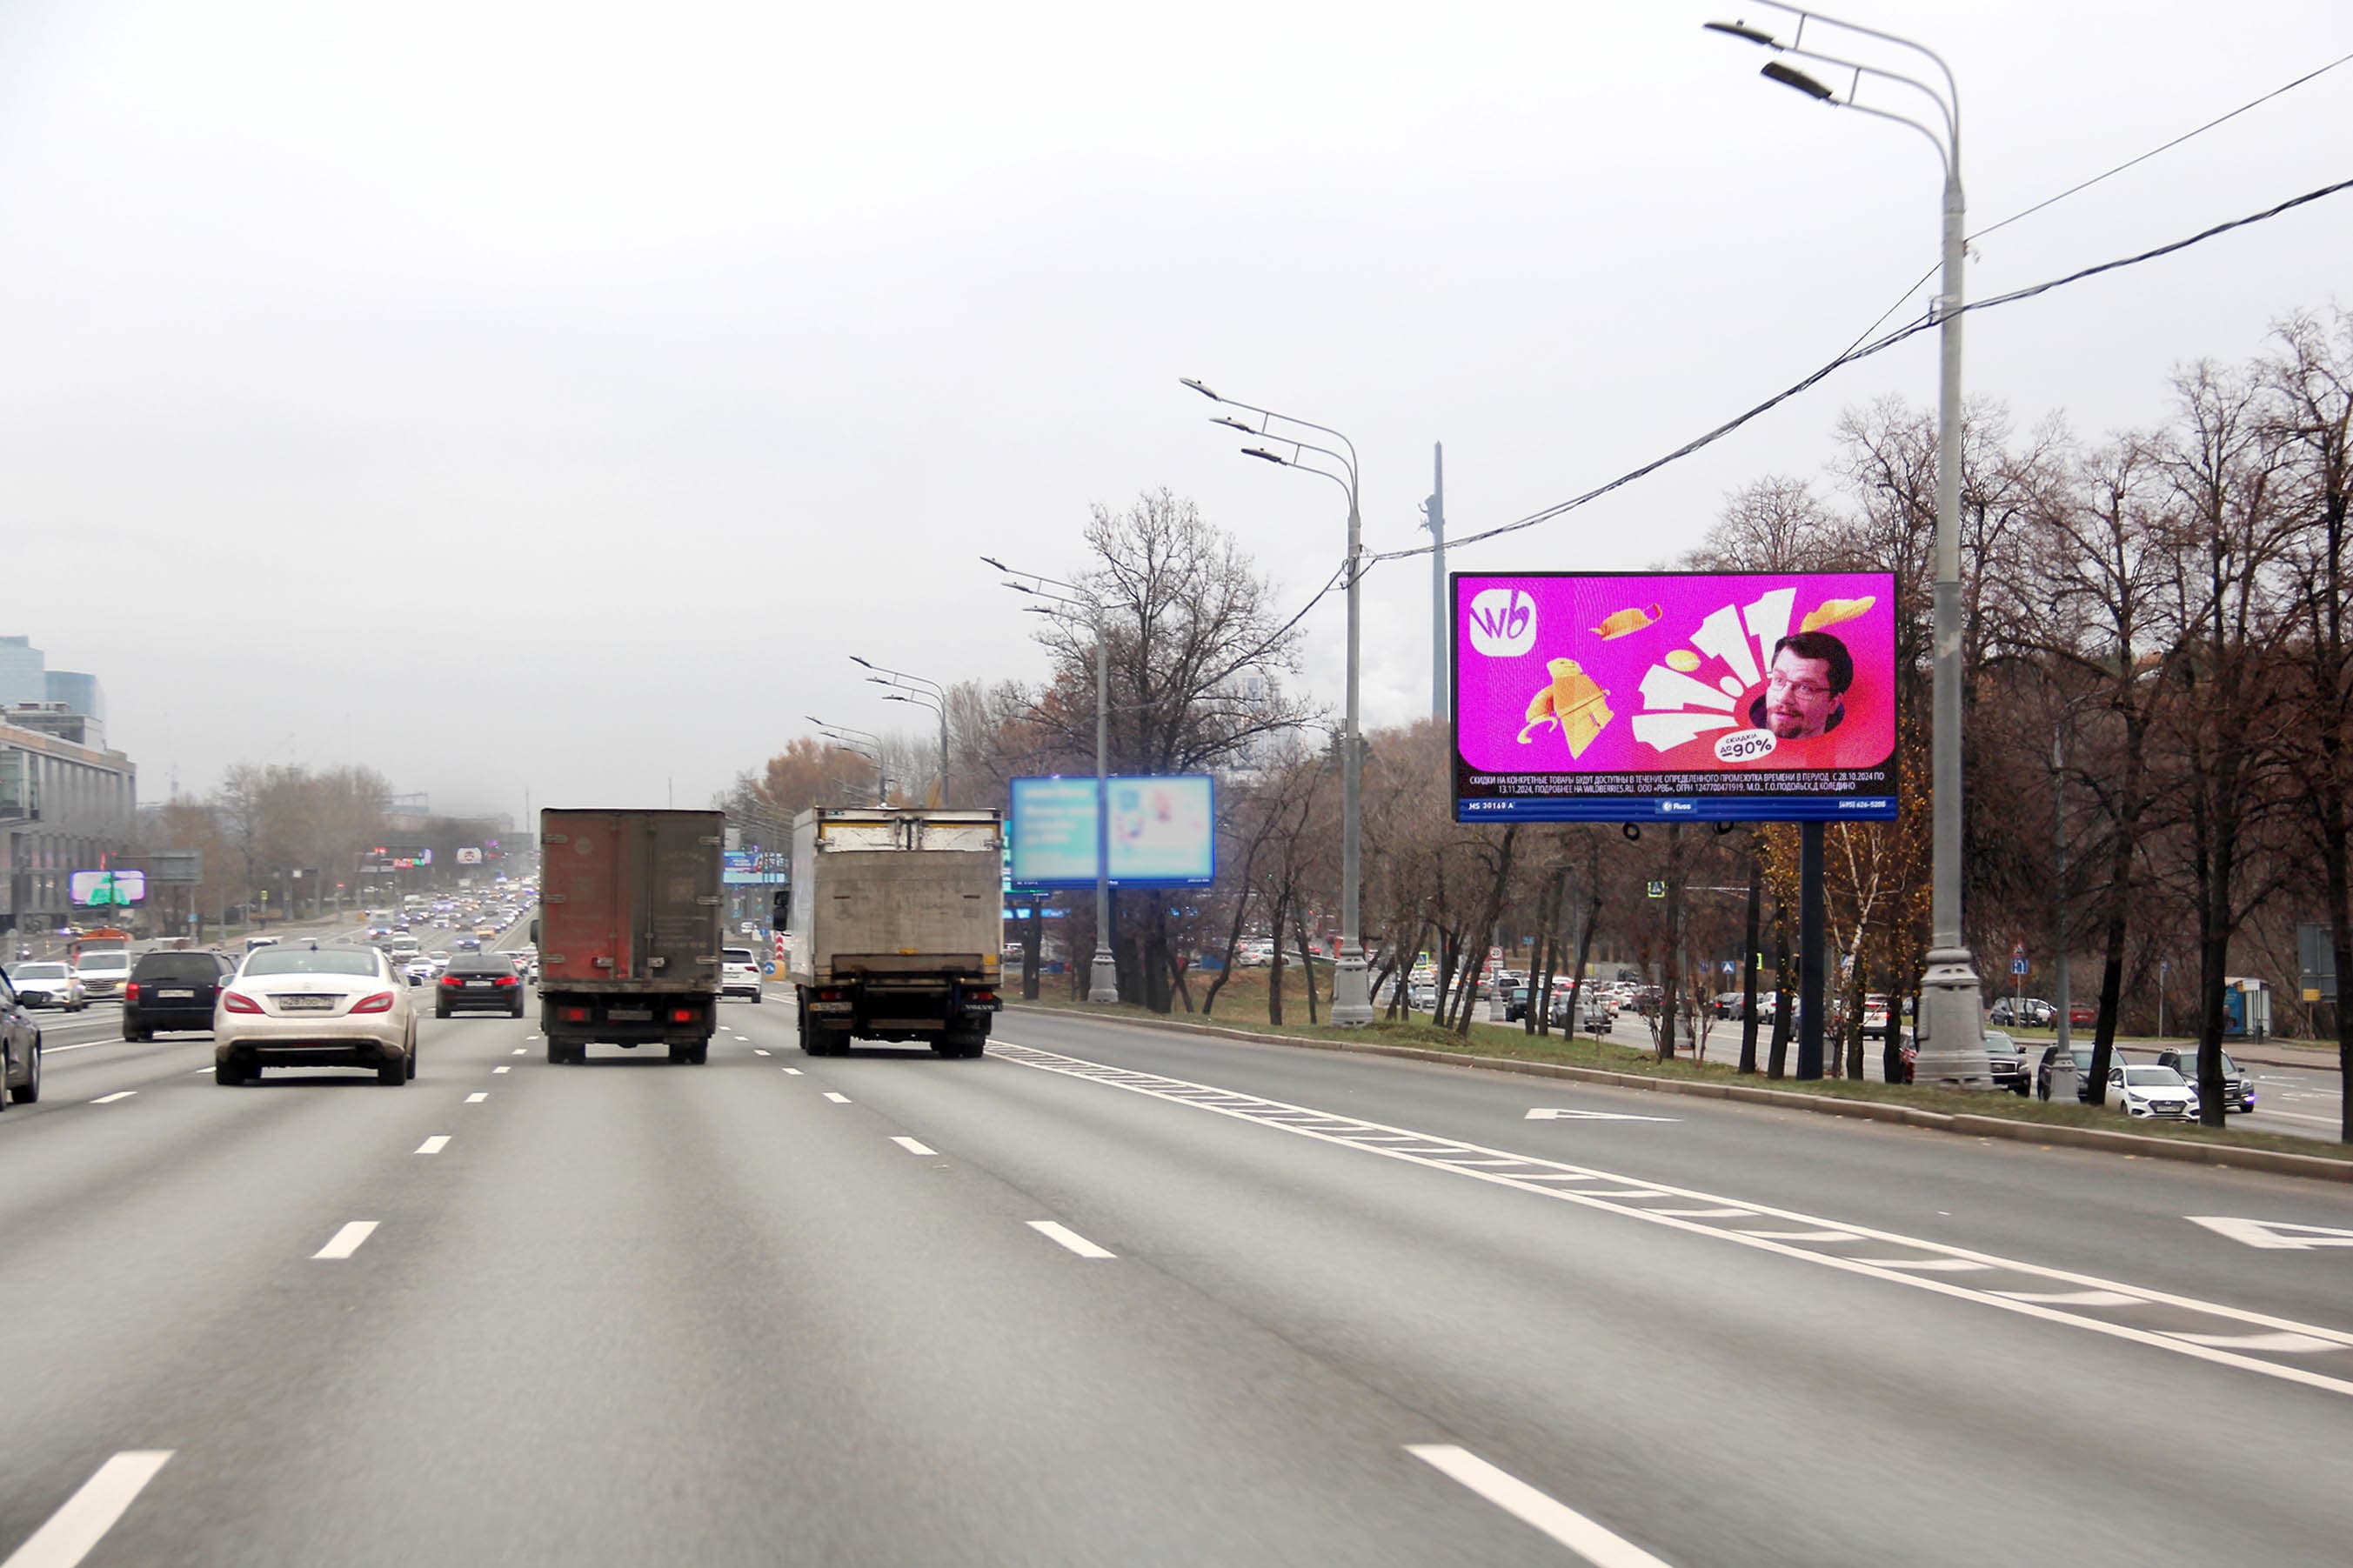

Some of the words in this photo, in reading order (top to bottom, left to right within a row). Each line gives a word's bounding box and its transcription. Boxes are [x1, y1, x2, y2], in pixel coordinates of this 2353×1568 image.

[1725, 733, 1758, 744] СКИДКИ
[1733, 738, 1772, 757] 90%
[1470, 776, 1495, 784] СКИДКИ
[1507, 776, 1547, 784] КОНКРЕТНЫЕ
[1575, 776, 1593, 784] БУДУТ
[1594, 776, 1628, 784] ДОСТУПНЫ
[1635, 775, 1663, 784] ТЕЧЕНИЕ
[1664, 774, 1719, 783] ОПРЕДЕЛЕННОГО
[1763, 773, 1795, 782] ВРЕМЕНИ
[1535, 785, 1573, 794] ПОДРОБНЕЕ
[1637, 784, 1652, 793] ООО
[1676, 784, 1693, 792] ОГРН
[1819, 781, 1855, 791] КОЛЕДИНО
